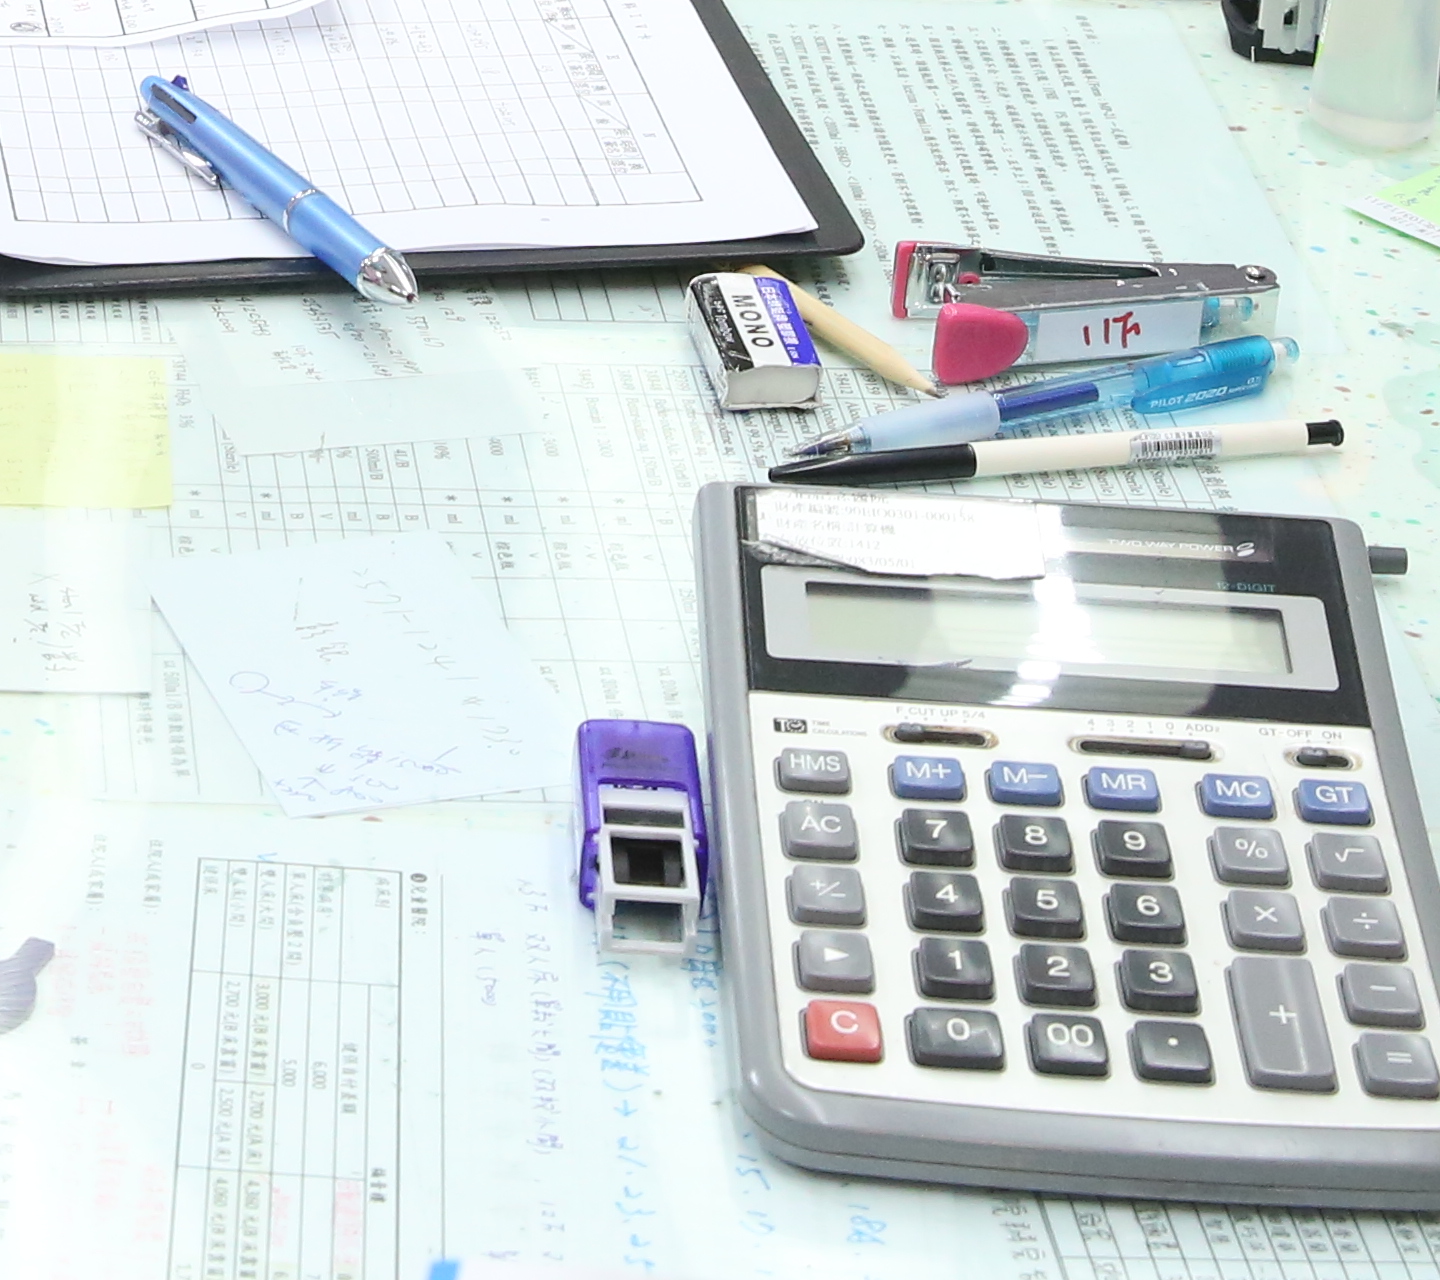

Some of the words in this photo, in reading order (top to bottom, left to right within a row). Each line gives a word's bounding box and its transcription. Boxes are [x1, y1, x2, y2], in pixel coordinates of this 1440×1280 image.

[731, 294, 775, 348] MONO
[1150, 395, 1184, 408] PILOT
[1185, 387, 1228, 403] 2020
[364, 448, 382, 481] 500ml/B
[1179, 541, 1234, 552] POWER
[908, 707, 937, 717] CUT
[941, 709, 959, 718] UP
[962, 710, 986, 719] 5/4
[1259, 728, 1312, 739] GT-OFF
[1322, 731, 1342, 740] ON
[790, 754, 841, 771] HMS
[905, 762, 952, 779] M+
[1101, 773, 1147, 790] MR
[1216, 780, 1261, 798] MC
[1315, 786, 1353, 803] GT
[800, 815, 842, 834] AC
[925, 819, 948, 839] 7
[1024, 825, 1048, 844] 8
[1123, 832, 1146, 851] 9
[935, 884, 959, 903] 4
[1036, 890, 1059, 910] 5
[1136, 896, 1160, 916] 6
[948, 951, 962, 970] 1
[1046, 956, 1070, 977] 2
[1149, 962, 1173, 983] 3
[224, 980, 241, 1008] 2,700
[253, 983, 272, 1012] 3,000
[830, 1010, 859, 1033] C
[946, 1018, 970, 1040] 0
[1046, 1022, 1094, 1047] 00
[311, 1061, 329, 1090] 6,000
[217, 1088, 235, 1116] 2,500
[248, 1090, 266, 1119] 2,700
